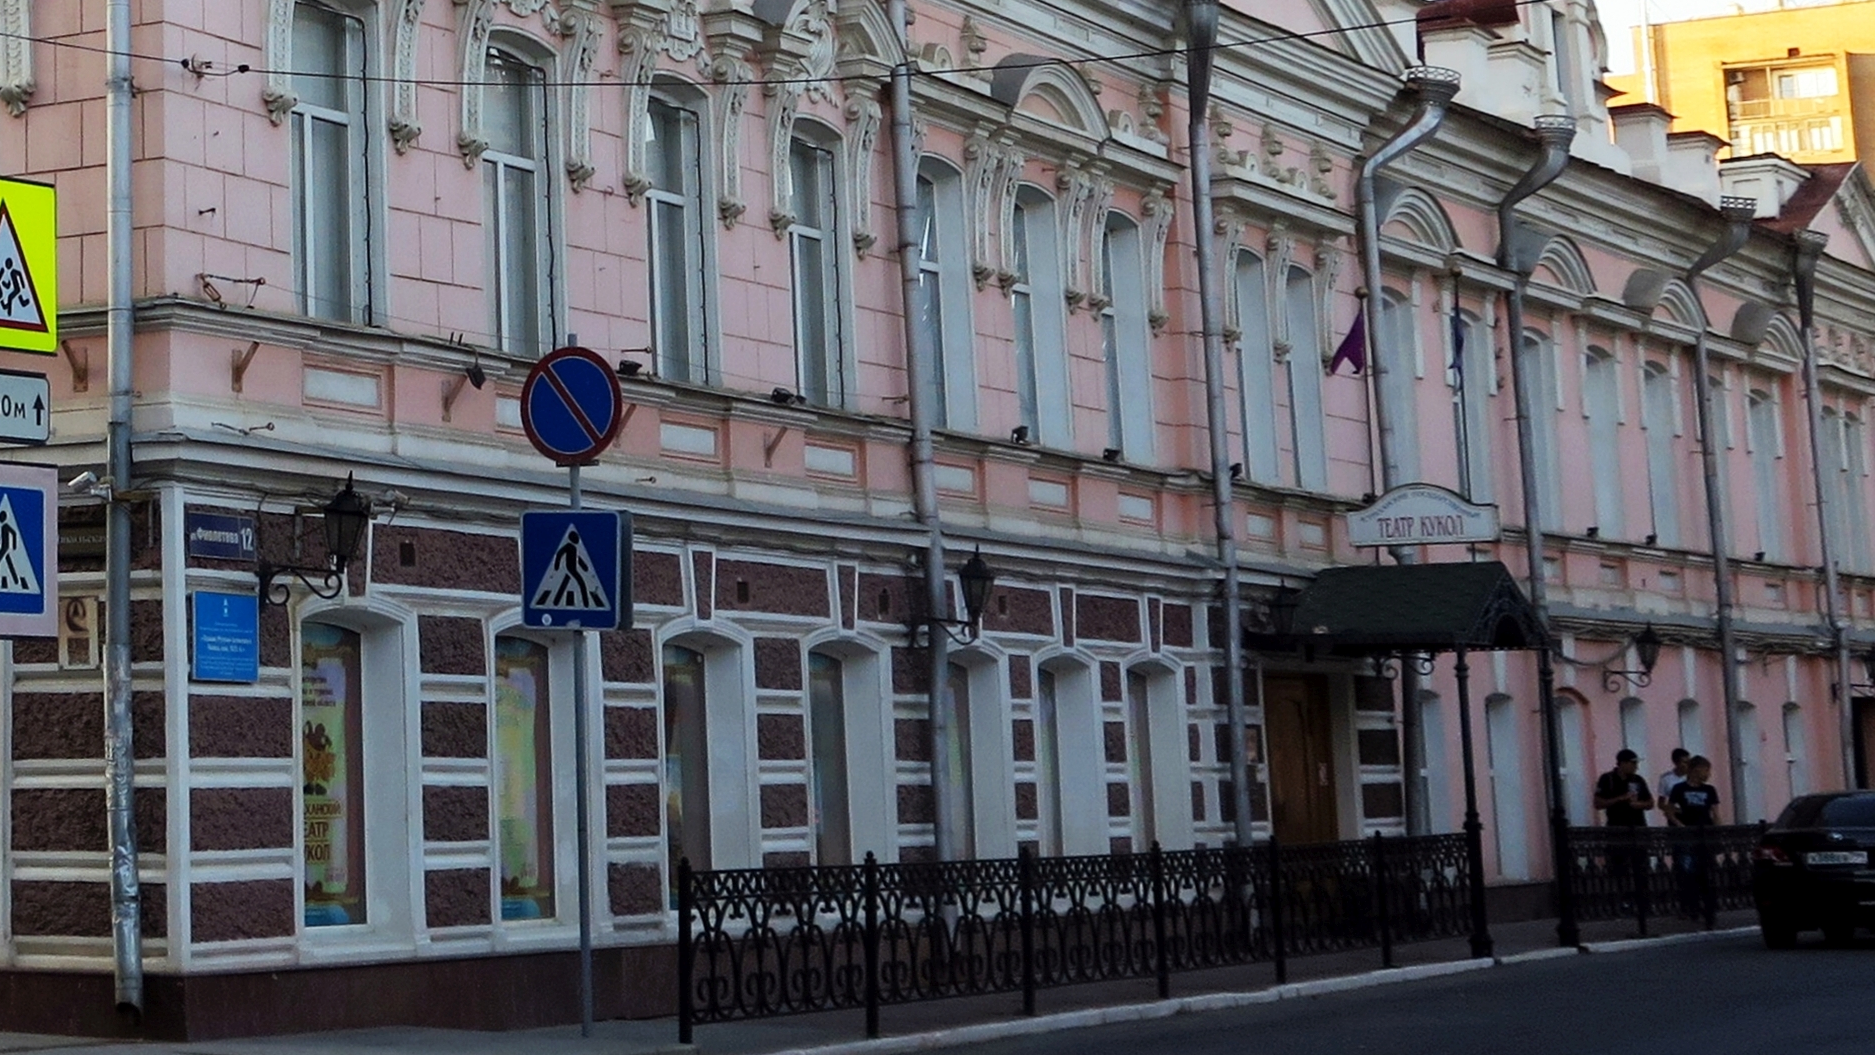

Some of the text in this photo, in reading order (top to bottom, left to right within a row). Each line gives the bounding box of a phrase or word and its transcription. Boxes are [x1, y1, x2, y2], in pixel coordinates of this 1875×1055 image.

[196, 526, 239, 544] Фиолетова
[240, 527, 254, 551] 12
[1376, 515, 1464, 538] ТЕАТР КУКОЛ
